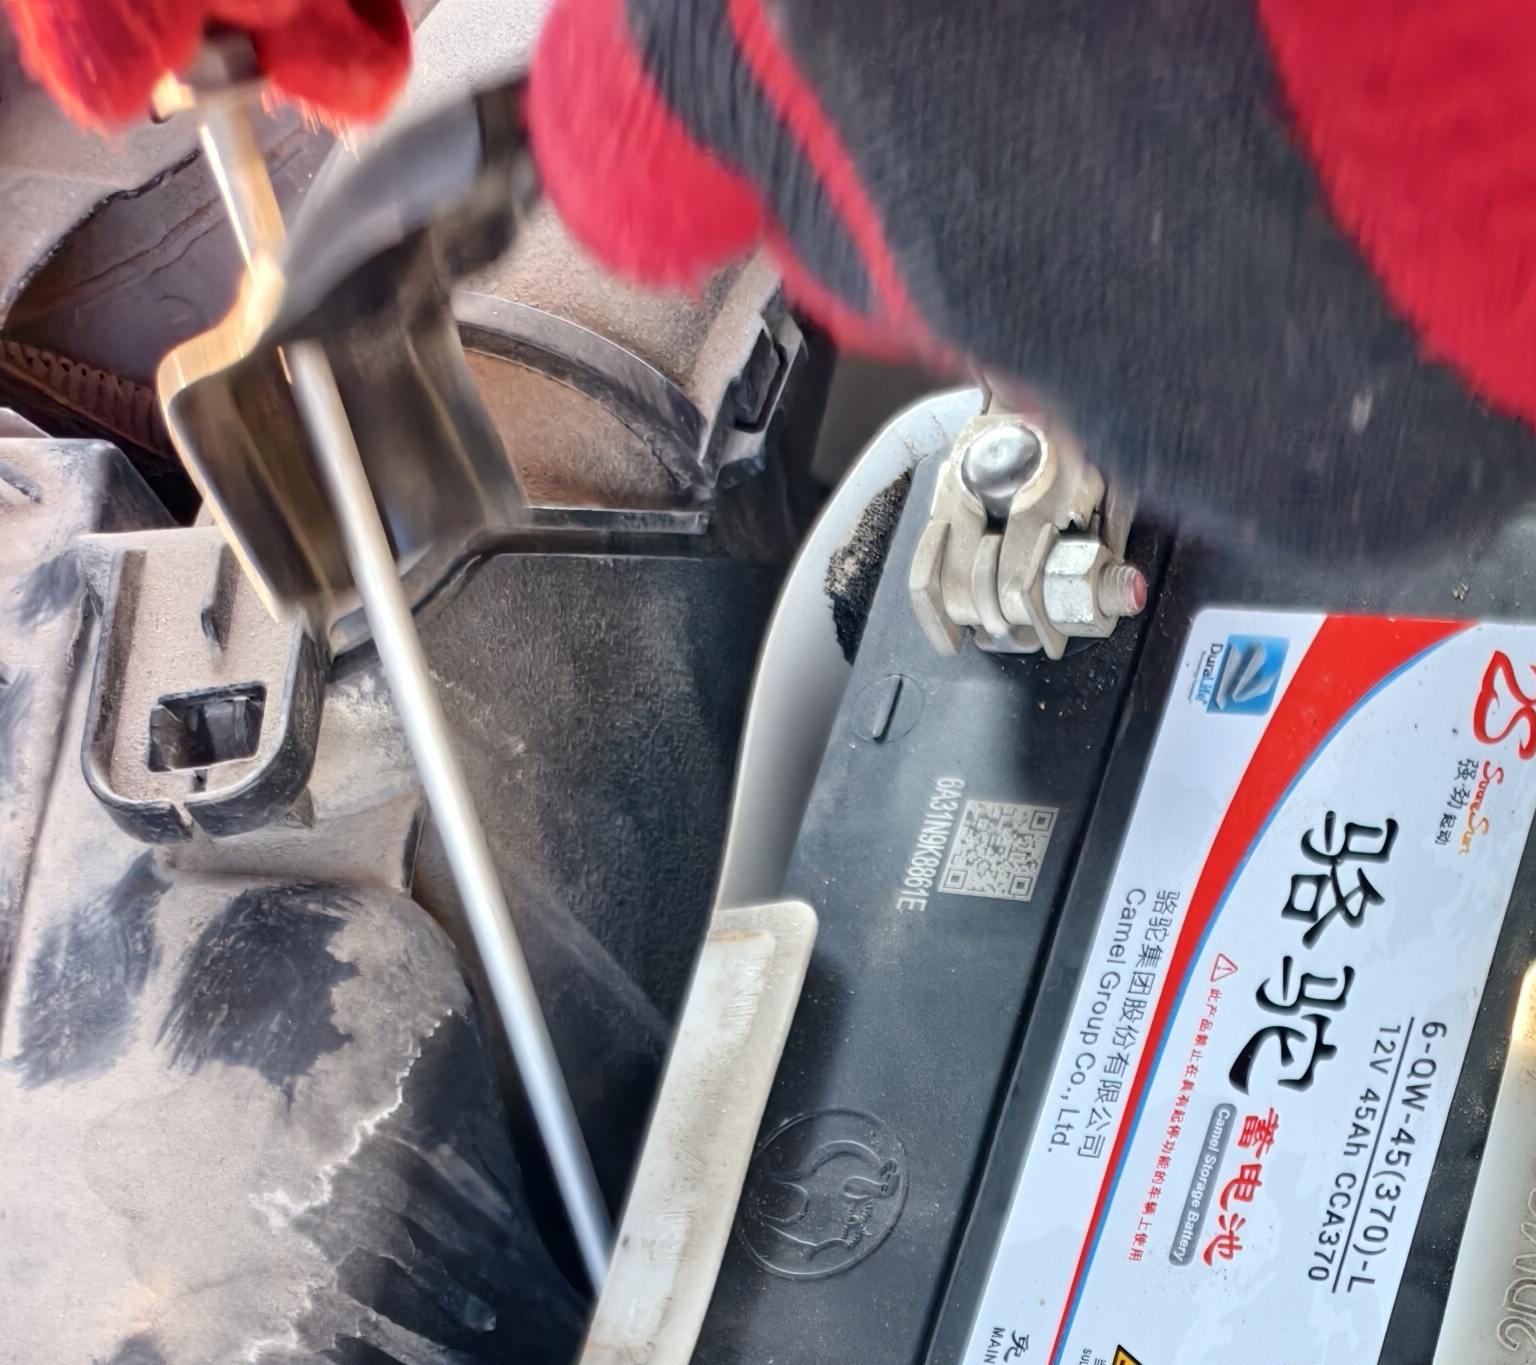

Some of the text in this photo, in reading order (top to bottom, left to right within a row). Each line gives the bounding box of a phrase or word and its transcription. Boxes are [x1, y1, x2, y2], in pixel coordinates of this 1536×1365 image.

[1047, 888, 1147, 1153] Camel Group Co., Ltd.
[1077, 889, 1181, 1159] 骆驼集团股份有限公司
[1228, 810, 1399, 1095] 骆驼
[1173, 1108, 1231, 1262] Camel Storage Battery
[1201, 1107, 1279, 1266] 蓄电池
[1307, 1025, 1402, 1282] 12V 45Ah CCA370
[1346, 1021, 1448, 1293] 6-QW-45(370)-L
